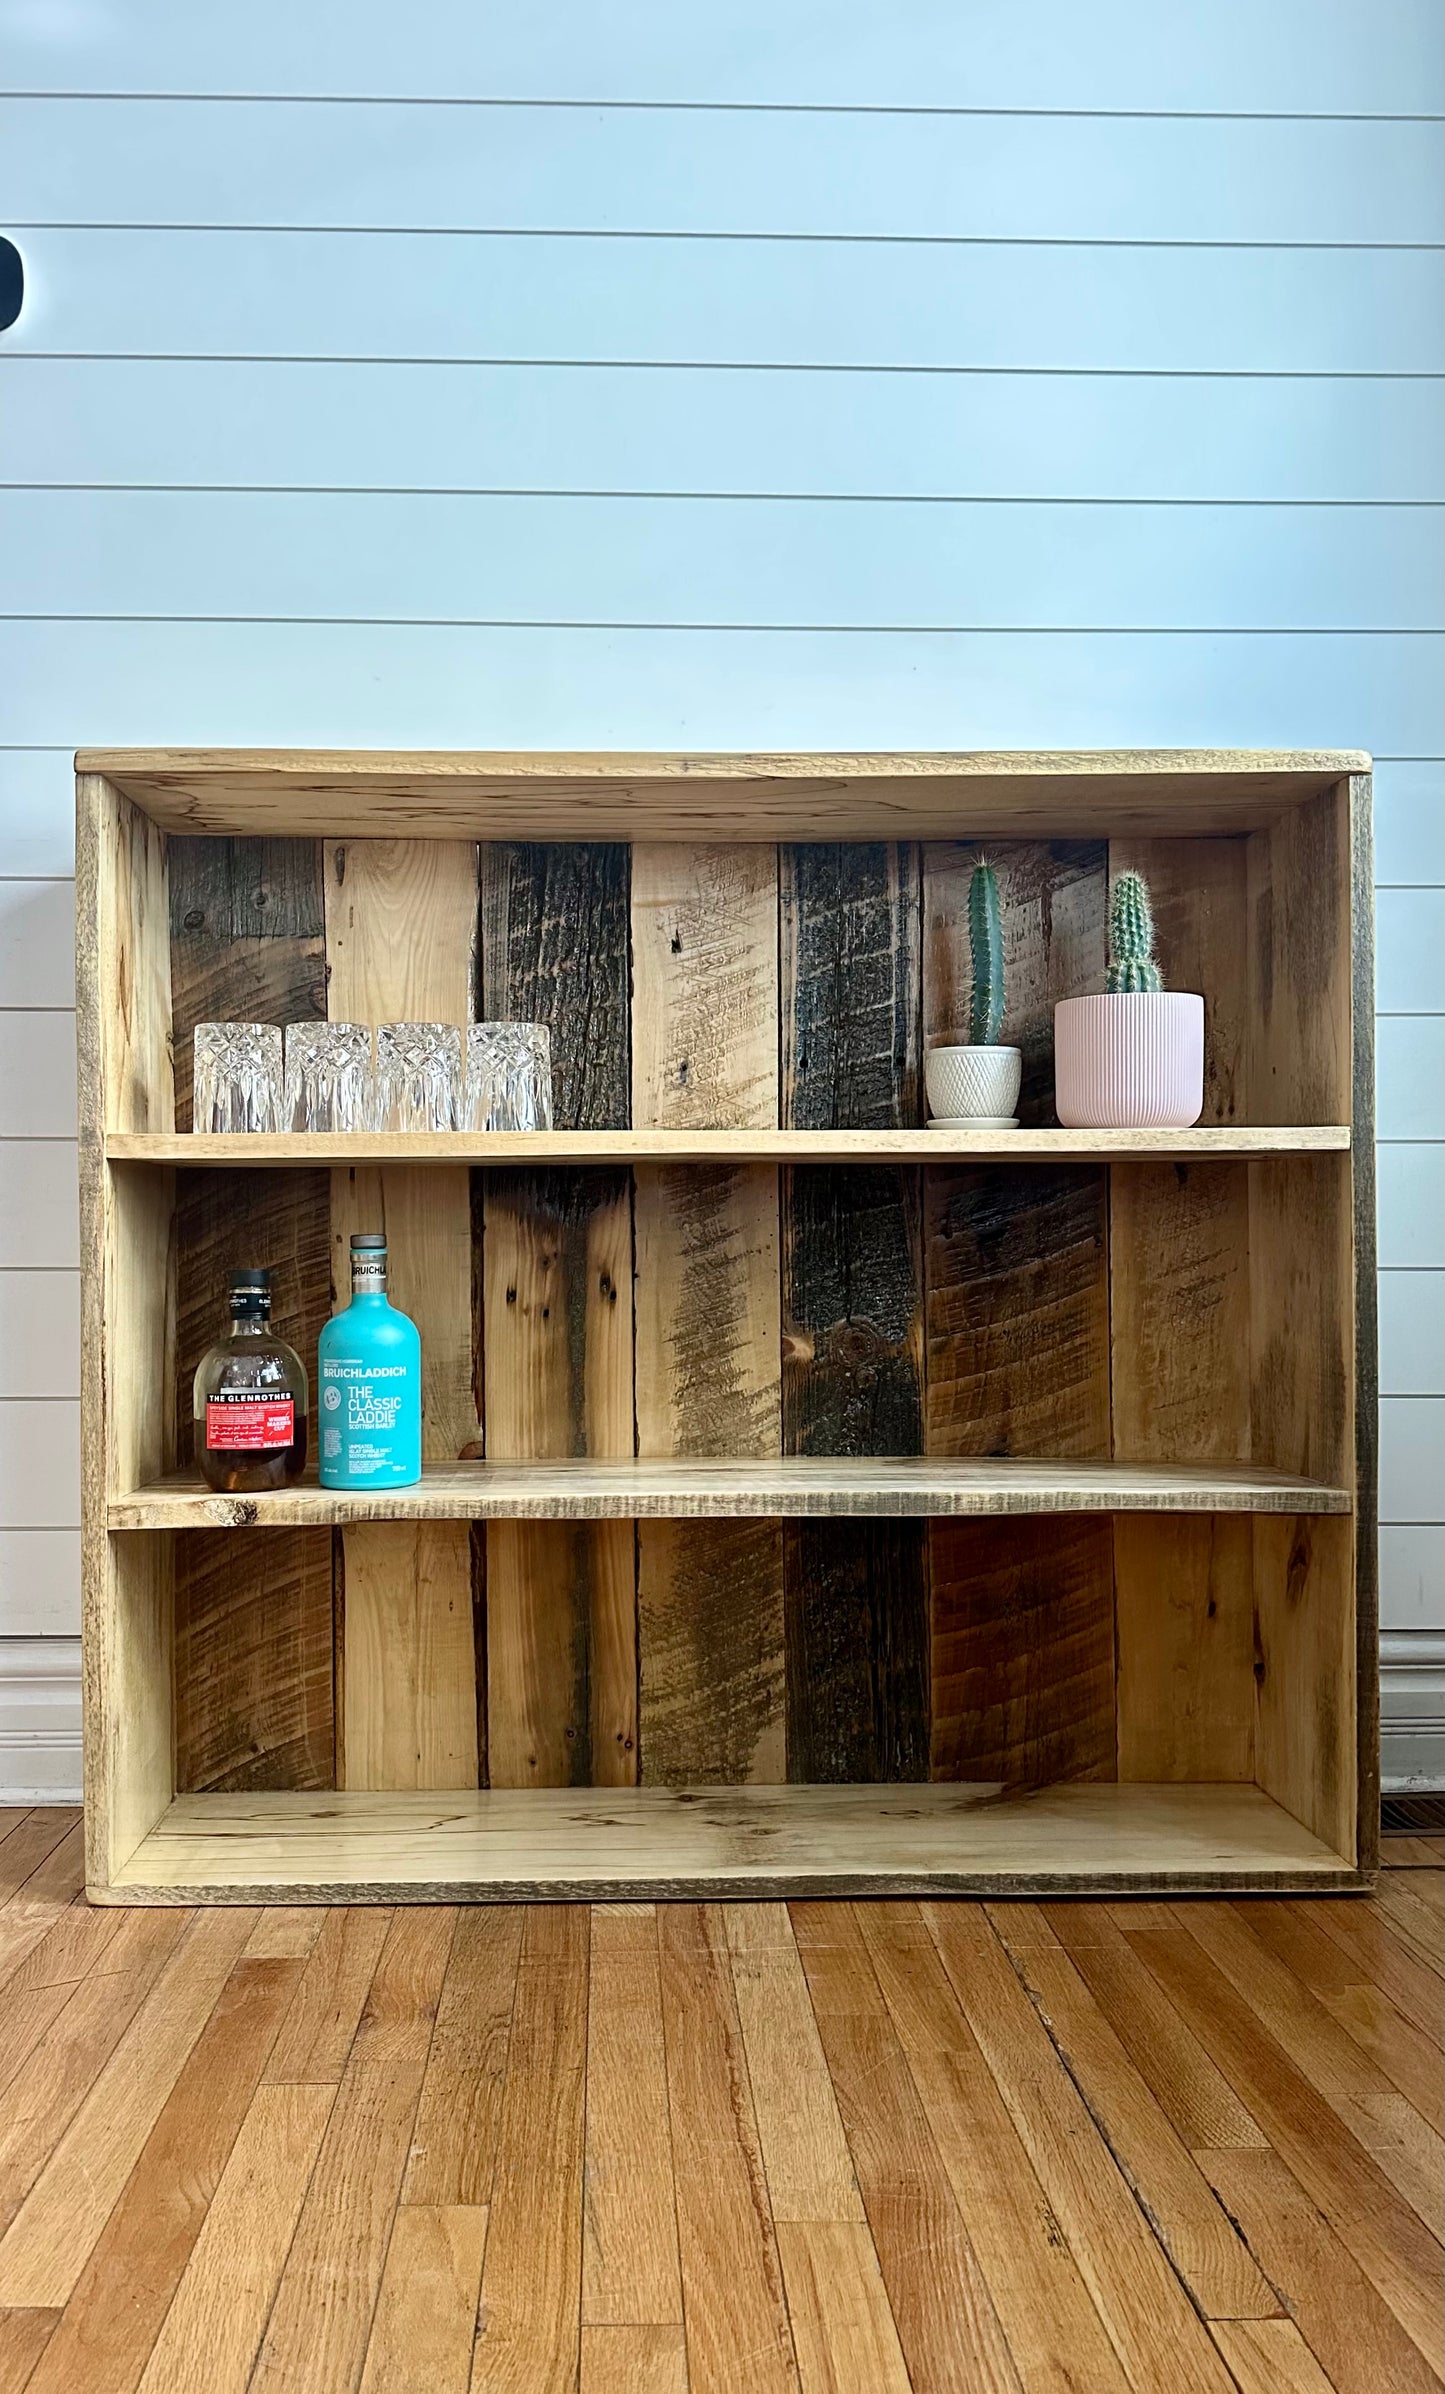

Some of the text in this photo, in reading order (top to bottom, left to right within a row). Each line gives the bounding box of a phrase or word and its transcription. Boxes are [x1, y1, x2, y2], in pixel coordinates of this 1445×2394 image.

[324, 1367, 406, 1378] BRUICHLADDICH
[209, 1392, 291, 1402] THE GLENROTHES
[347, 1386, 374, 1399] THE
[348, 1397, 402, 1411] CLASSIC
[348, 1410, 396, 1424] LADDIE
